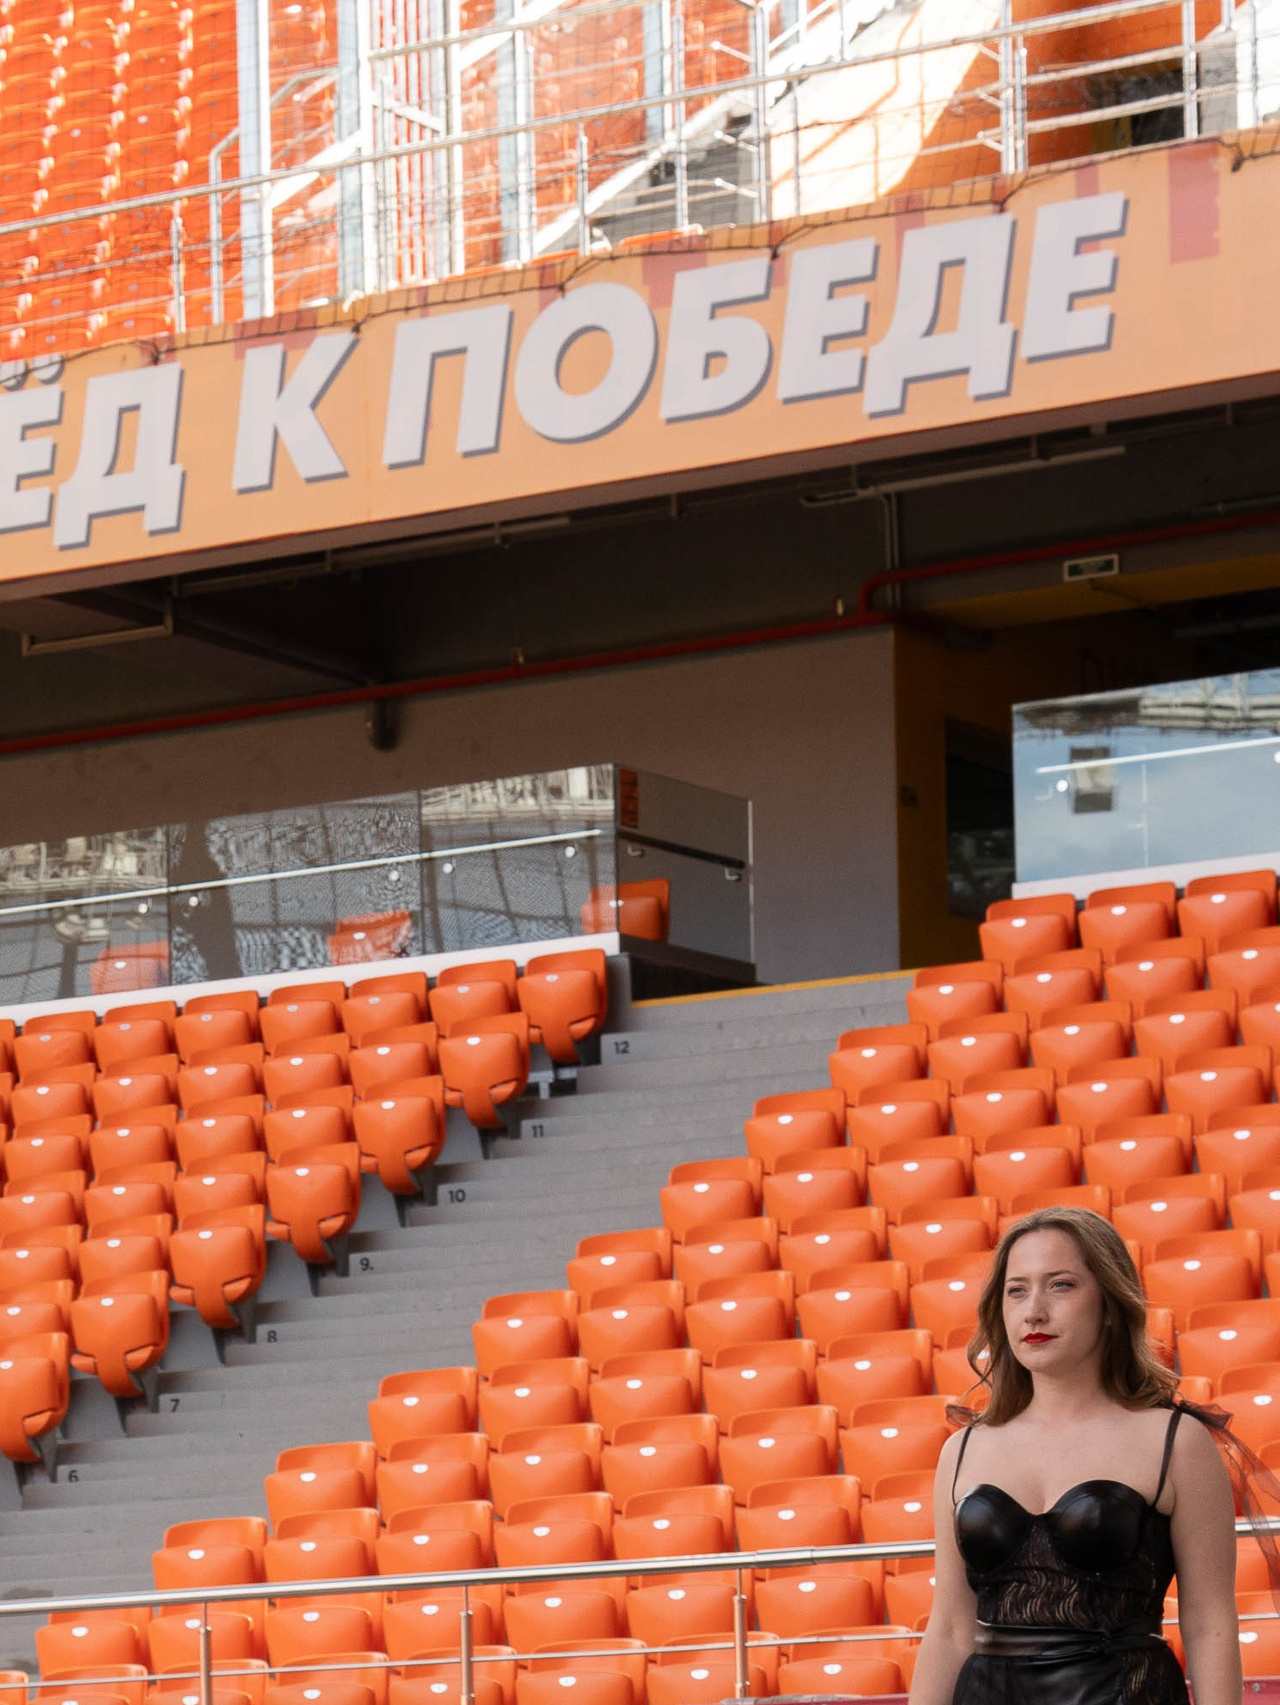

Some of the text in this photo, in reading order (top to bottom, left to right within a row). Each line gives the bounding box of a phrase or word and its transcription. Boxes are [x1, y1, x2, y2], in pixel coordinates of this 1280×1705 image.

[231, 331, 361, 495] К
[381, 190, 1128, 468] ПОБЕДЕ
[613, 1040, 630, 1055] 12
[531, 1124, 544, 1138] 11
[448, 1189, 466, 1203] 10
[267, 1330, 277, 1343] 8
[170, 1399, 180, 1413] 7
[68, 1469, 79, 1483] 6
